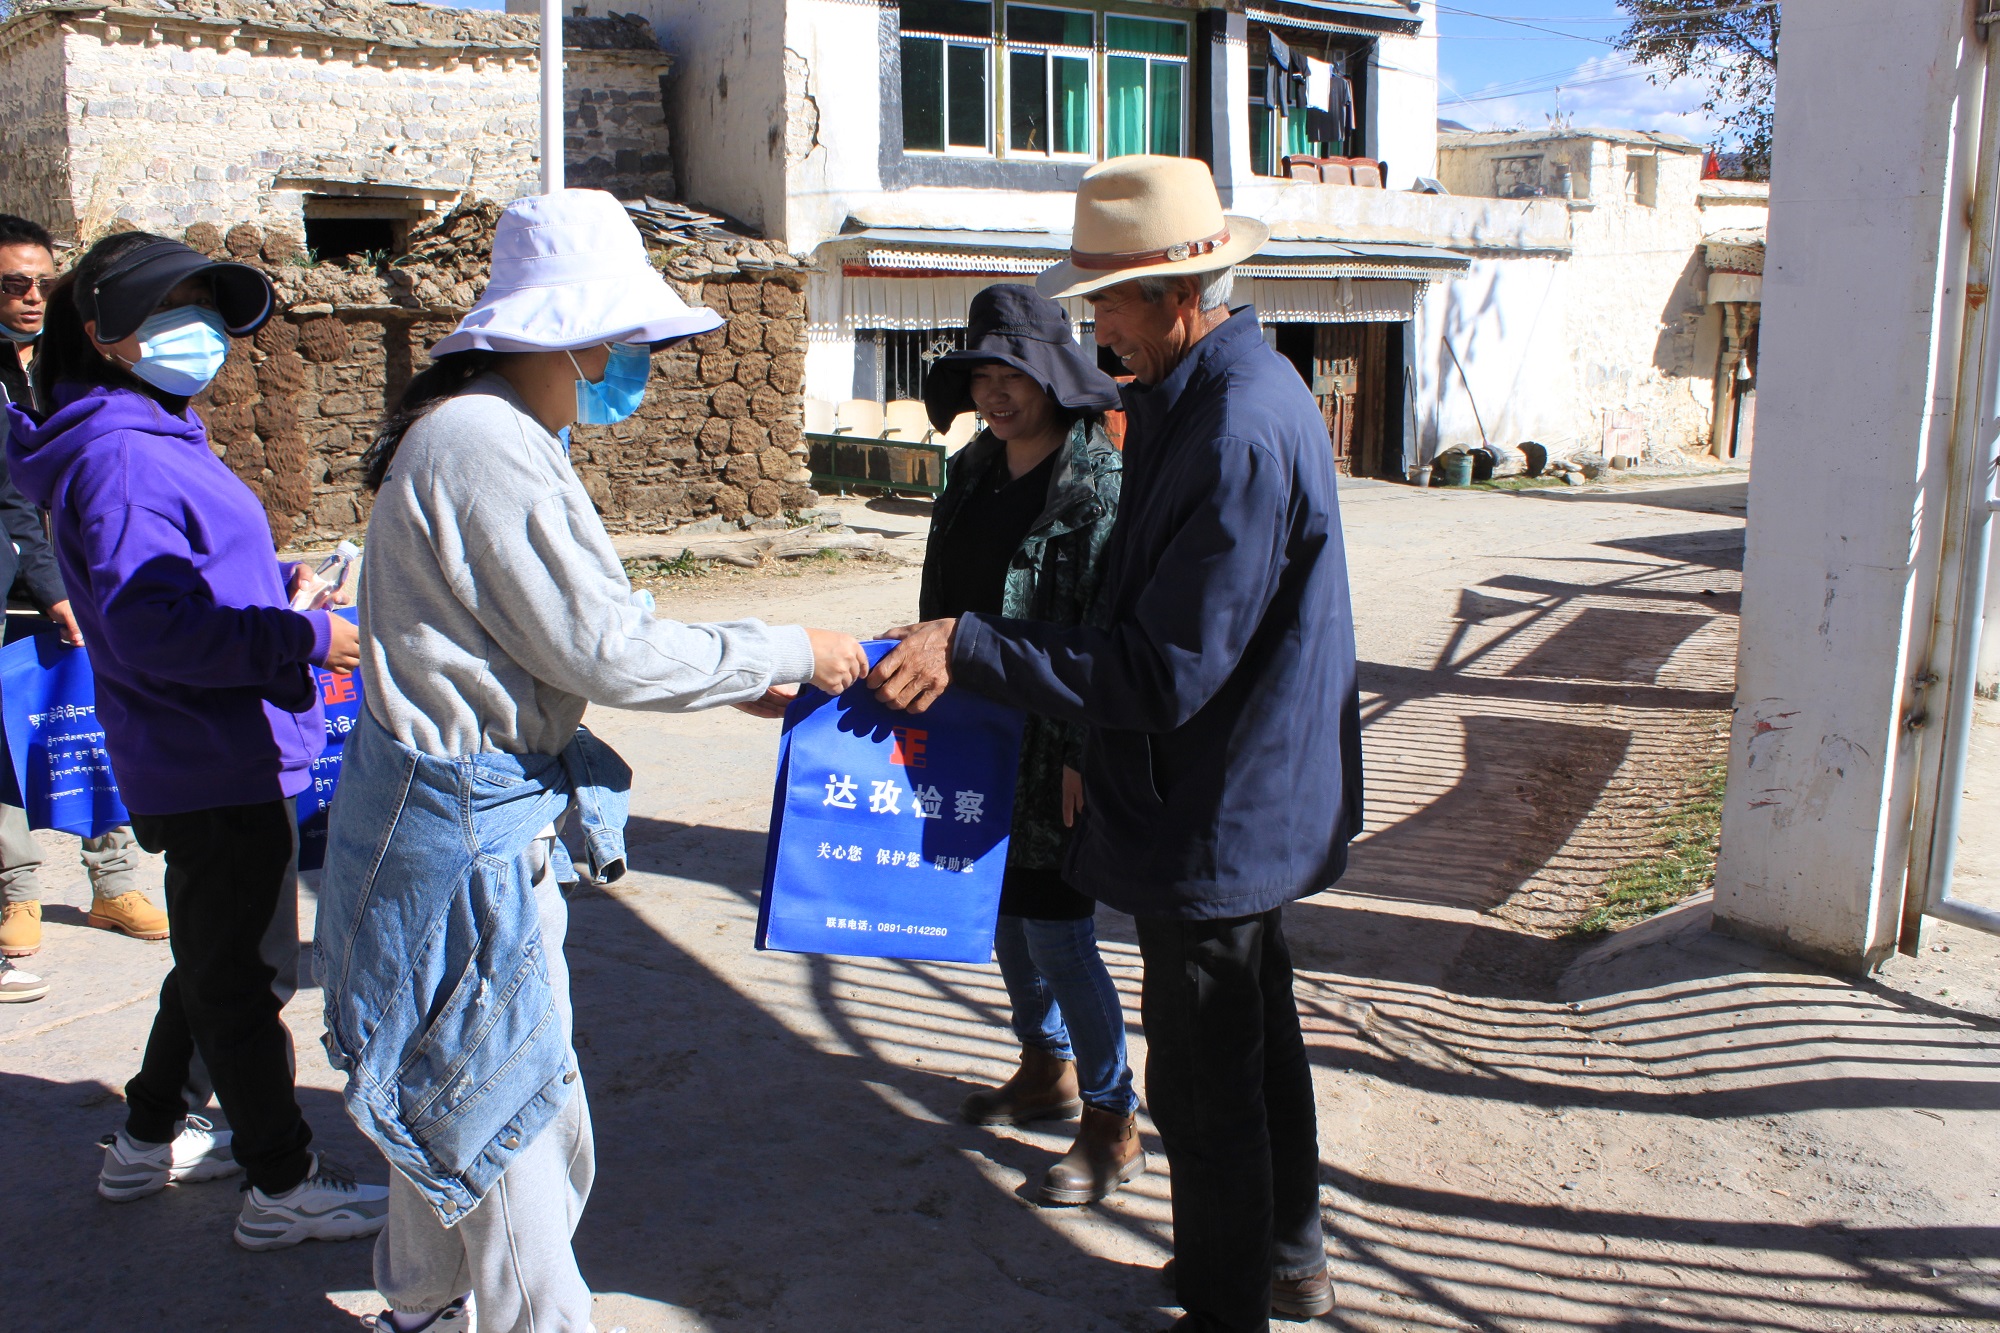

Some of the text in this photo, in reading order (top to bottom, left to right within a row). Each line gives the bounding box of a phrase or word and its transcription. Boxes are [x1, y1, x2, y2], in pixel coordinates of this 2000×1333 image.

[823, 773, 985, 824] 达孜检察
[816, 841, 974, 874] 关心您 保护您 帮助您
